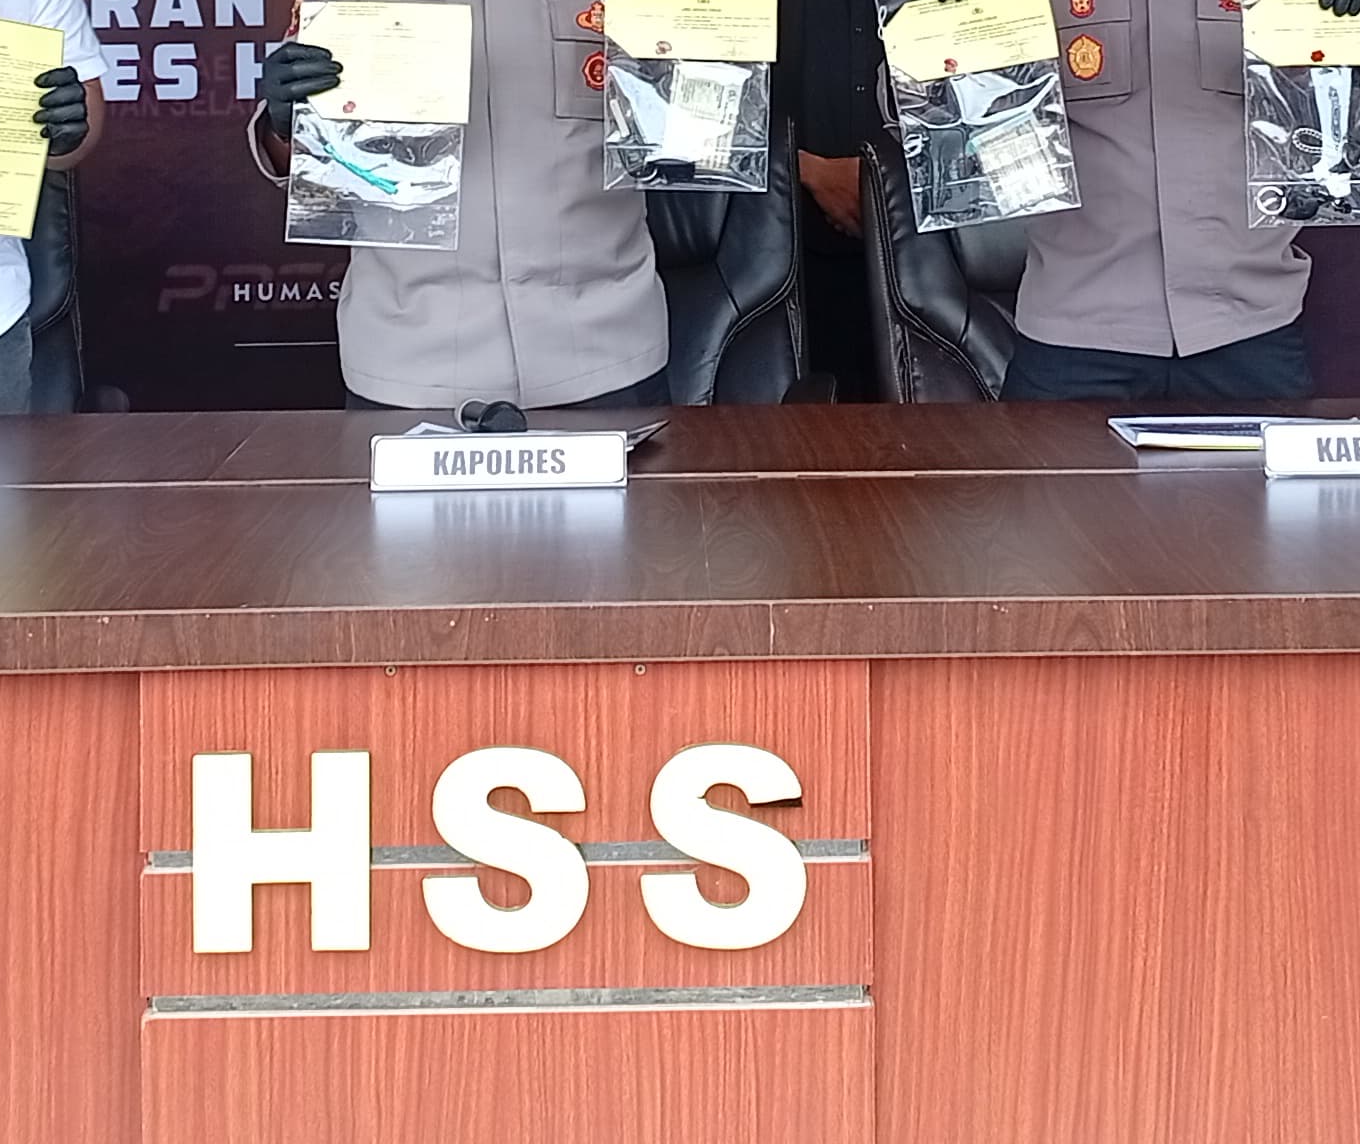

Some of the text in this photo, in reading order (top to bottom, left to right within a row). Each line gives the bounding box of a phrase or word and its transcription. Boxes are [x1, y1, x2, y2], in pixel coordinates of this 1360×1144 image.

[102, 42, 200, 102] ES
[232, 281, 340, 304] HUMAS
[433, 448, 566, 476] KAPOLRES
[192, 742, 807, 954] HSS
